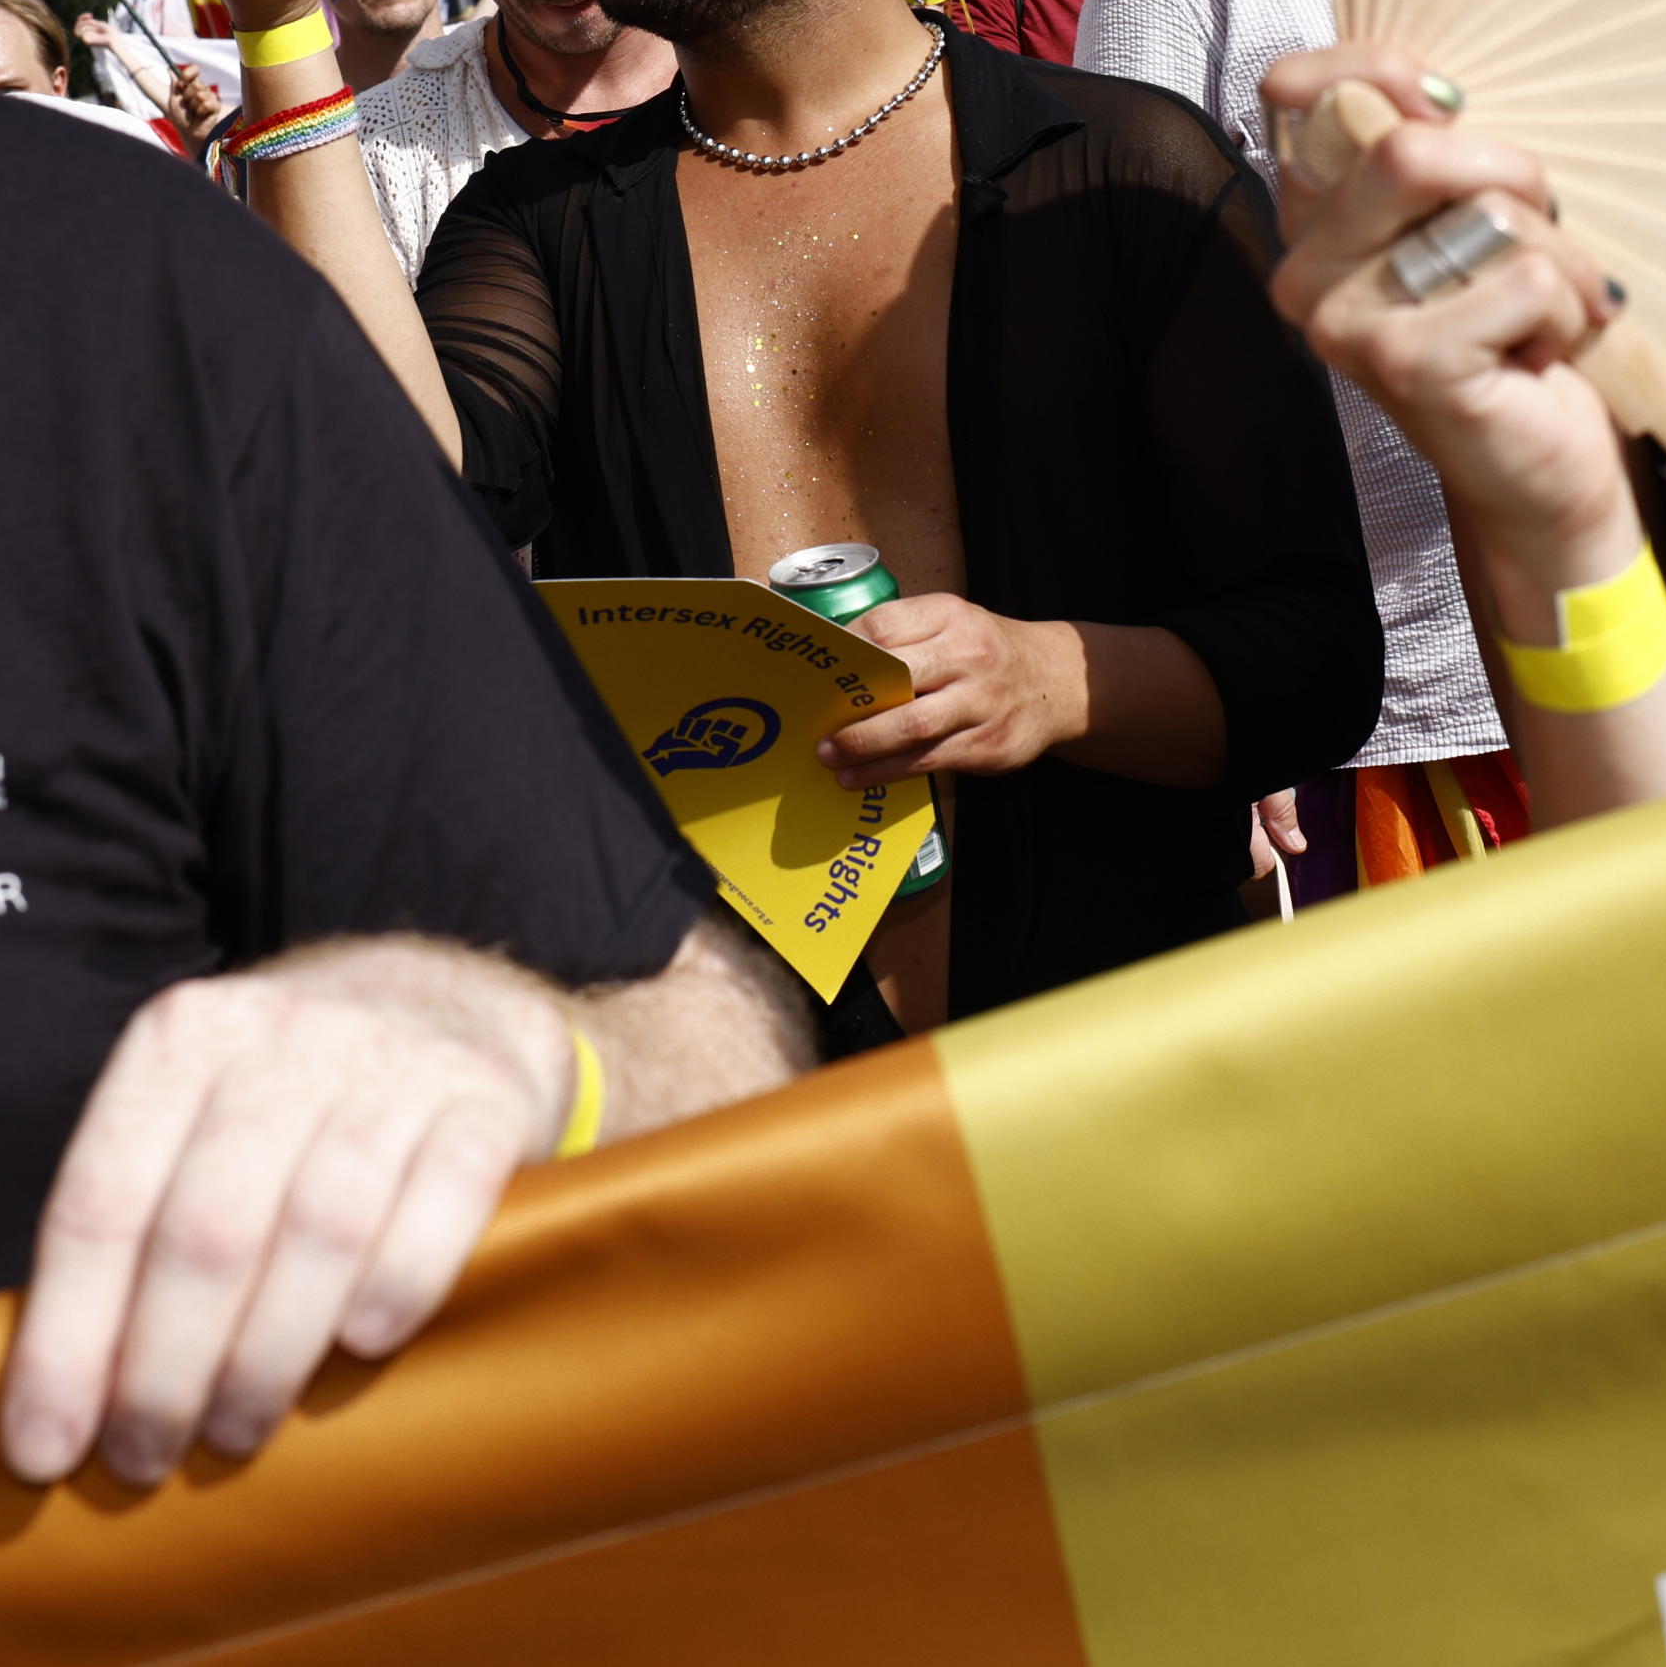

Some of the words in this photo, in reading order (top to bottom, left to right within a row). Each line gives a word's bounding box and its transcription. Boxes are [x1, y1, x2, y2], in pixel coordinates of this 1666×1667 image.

[578, 603, 740, 632] Intersex
[741, 615, 840, 671] Rights
[834, 671, 876, 709] are
[803, 831, 883, 934] Rights
